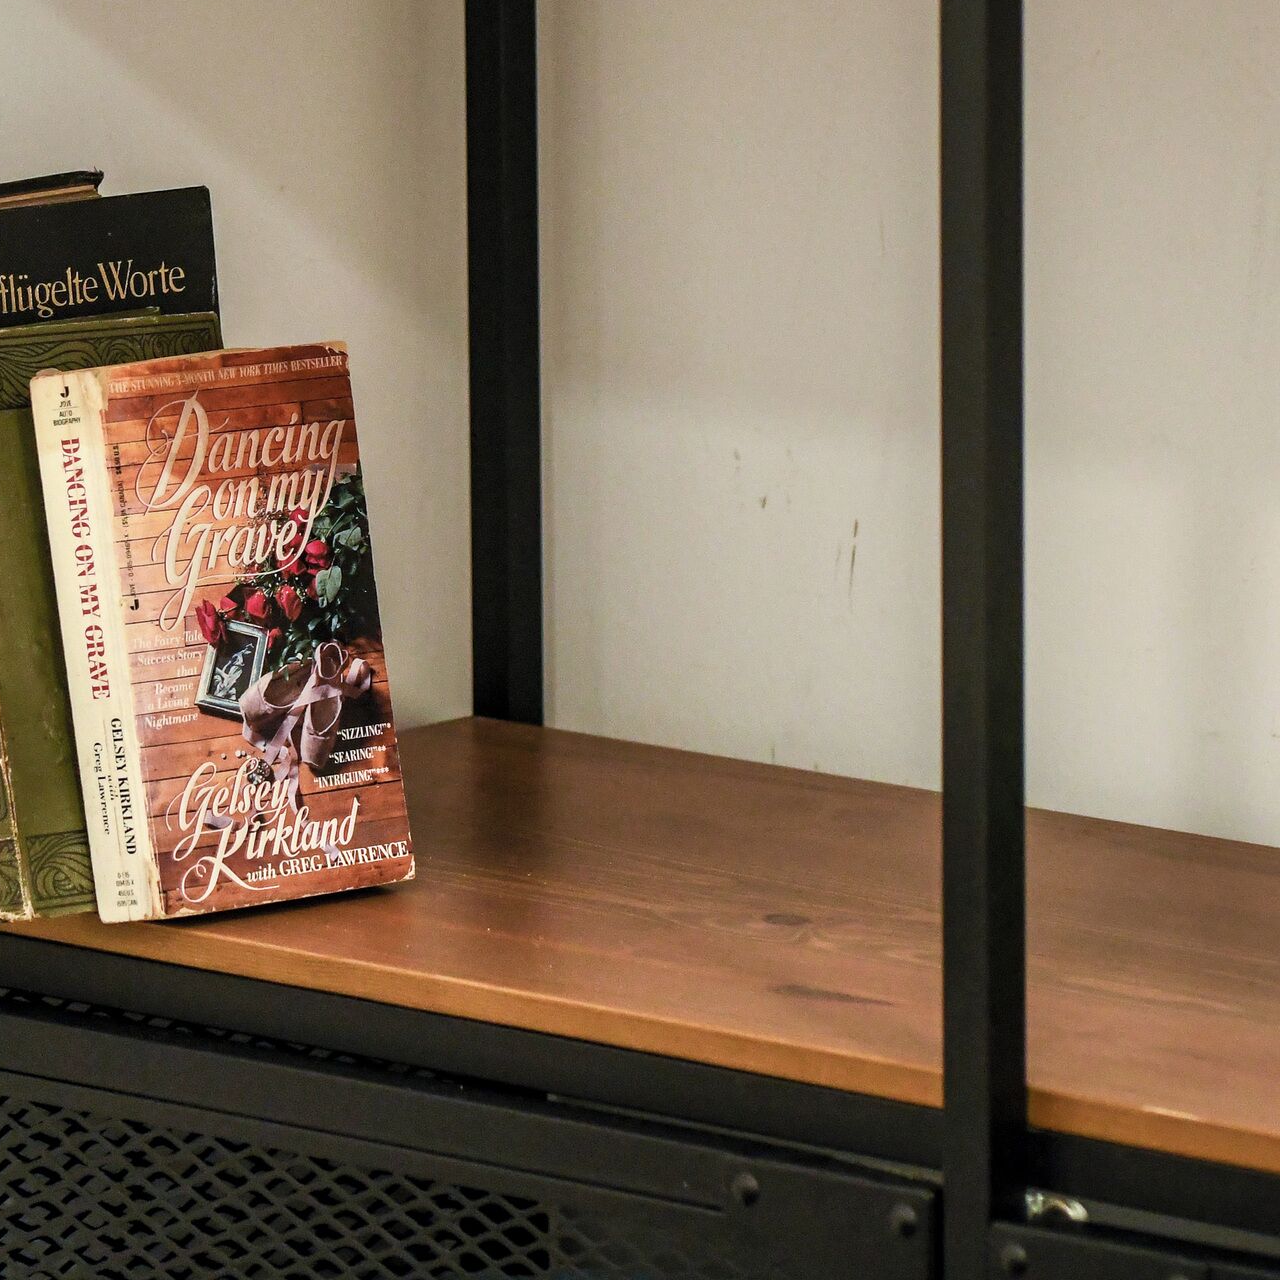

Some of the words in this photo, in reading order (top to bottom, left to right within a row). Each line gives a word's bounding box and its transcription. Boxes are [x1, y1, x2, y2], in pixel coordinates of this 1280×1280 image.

[97, 259, 186, 301] Worte
[109, 381, 129, 394] THE
[132, 377, 174, 391] STUNNING
[219, 368, 237, 381] NEW
[239, 365, 261, 378] YORK
[264, 361, 288, 375] TIMES
[291, 355, 343, 372] BESTSELLER
[135, 387, 346, 518] Dancing
[61, 437, 91, 538] DANCING
[213, 476, 261, 521] on
[75, 544, 96, 577] ON
[151, 484, 297, 632] Grave
[79, 583, 102, 618] MY
[85, 624, 111, 700] GRAVE
[133, 638, 151, 648] The
[138, 653, 176, 666] Success
[177, 649, 204, 662] Story
[155, 682, 194, 695] Became
[177, 665, 198, 677] that
[145, 712, 199, 730] Nightmare
[158, 696, 190, 709] Living
[93, 742, 103, 772] Greg
[111, 717, 127, 772] GELSEY
[97, 775, 110, 835] Lawrence
[118, 777, 137, 855] KIRKLAND
[166, 757, 290, 862] Gelsey
[181, 797, 361, 903] Kirkland
[246, 862, 277, 883] with
[279, 855, 323, 877] GREG
[326, 841, 409, 870] LAWRENCE
